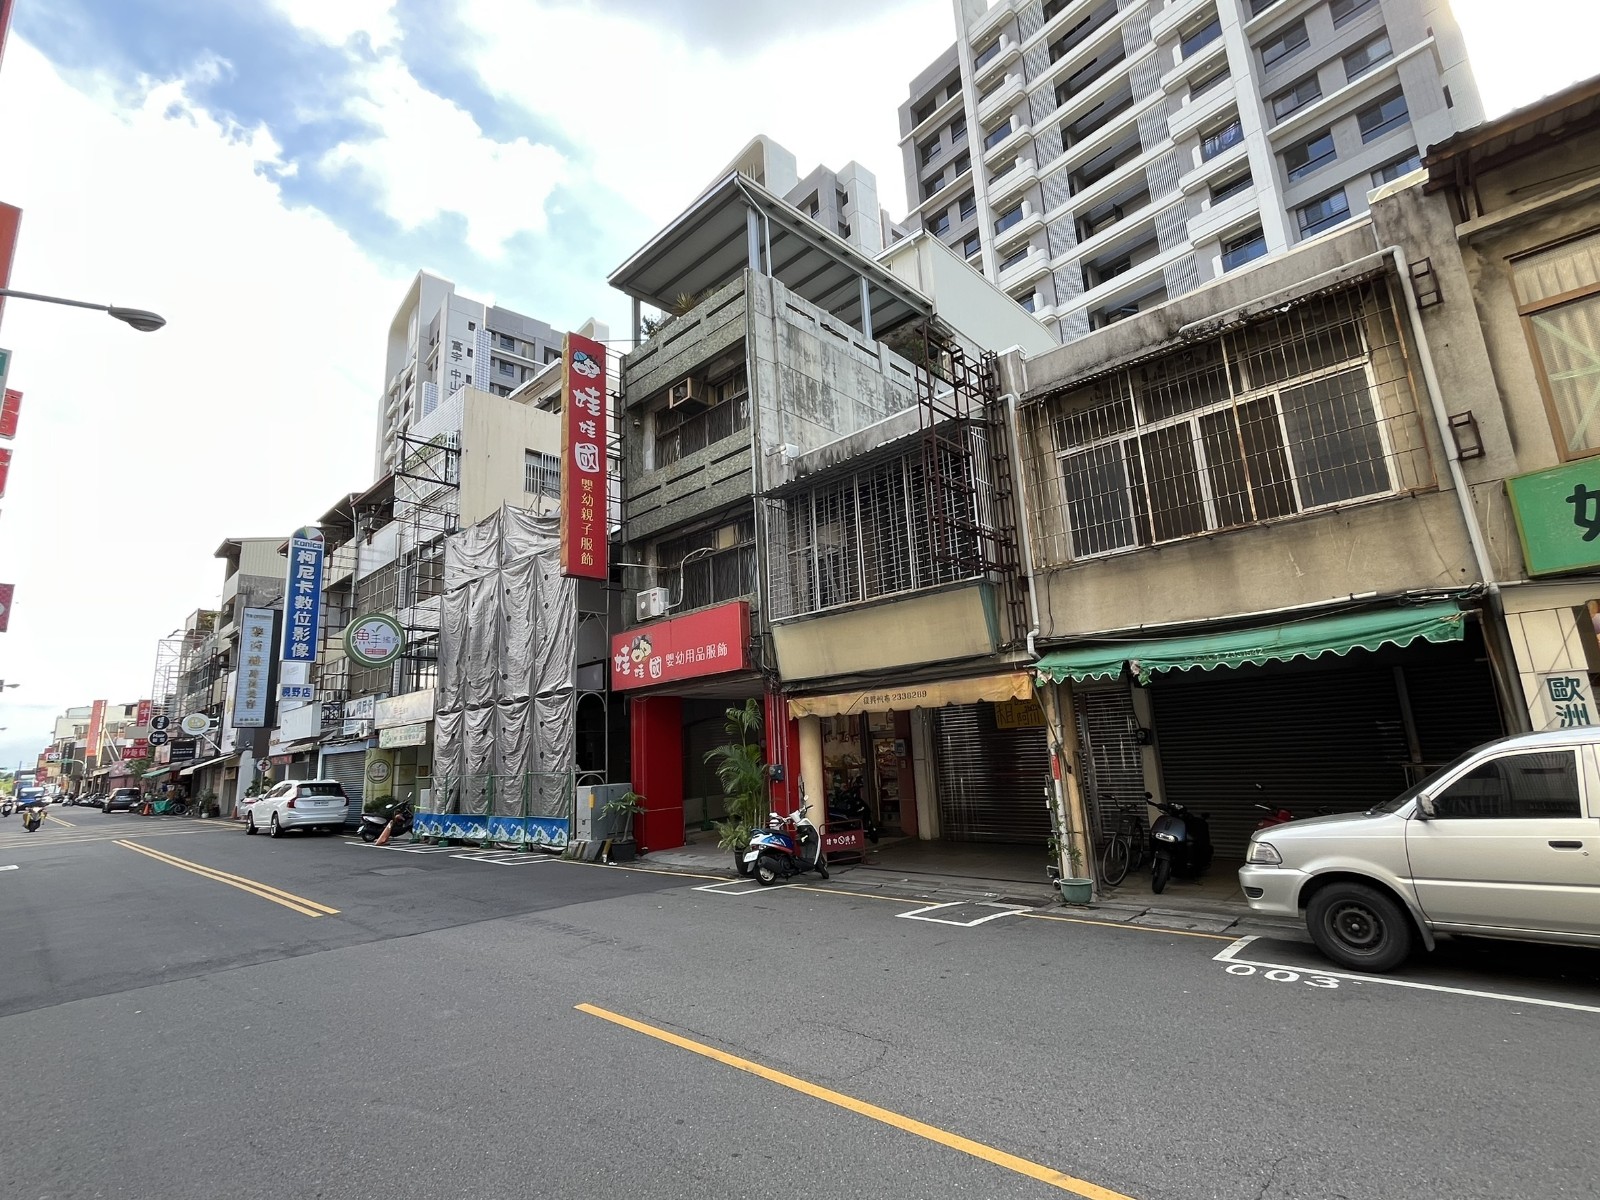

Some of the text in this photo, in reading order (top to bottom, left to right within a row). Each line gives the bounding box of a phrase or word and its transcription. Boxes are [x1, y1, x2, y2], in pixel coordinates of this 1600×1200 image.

[573, 386, 600, 472] 娃娃國
[293, 539, 322, 549] Konica
[580, 478, 593, 566] 嬰幼親子服飾
[291, 550, 317, 658] 柯尼卡數位影像
[614, 642, 728, 679] 娃娃國 嬰幼用品服飾
[1546, 676, 1590, 728] 歐洲
[1225, 964, 1340, 989] 003
